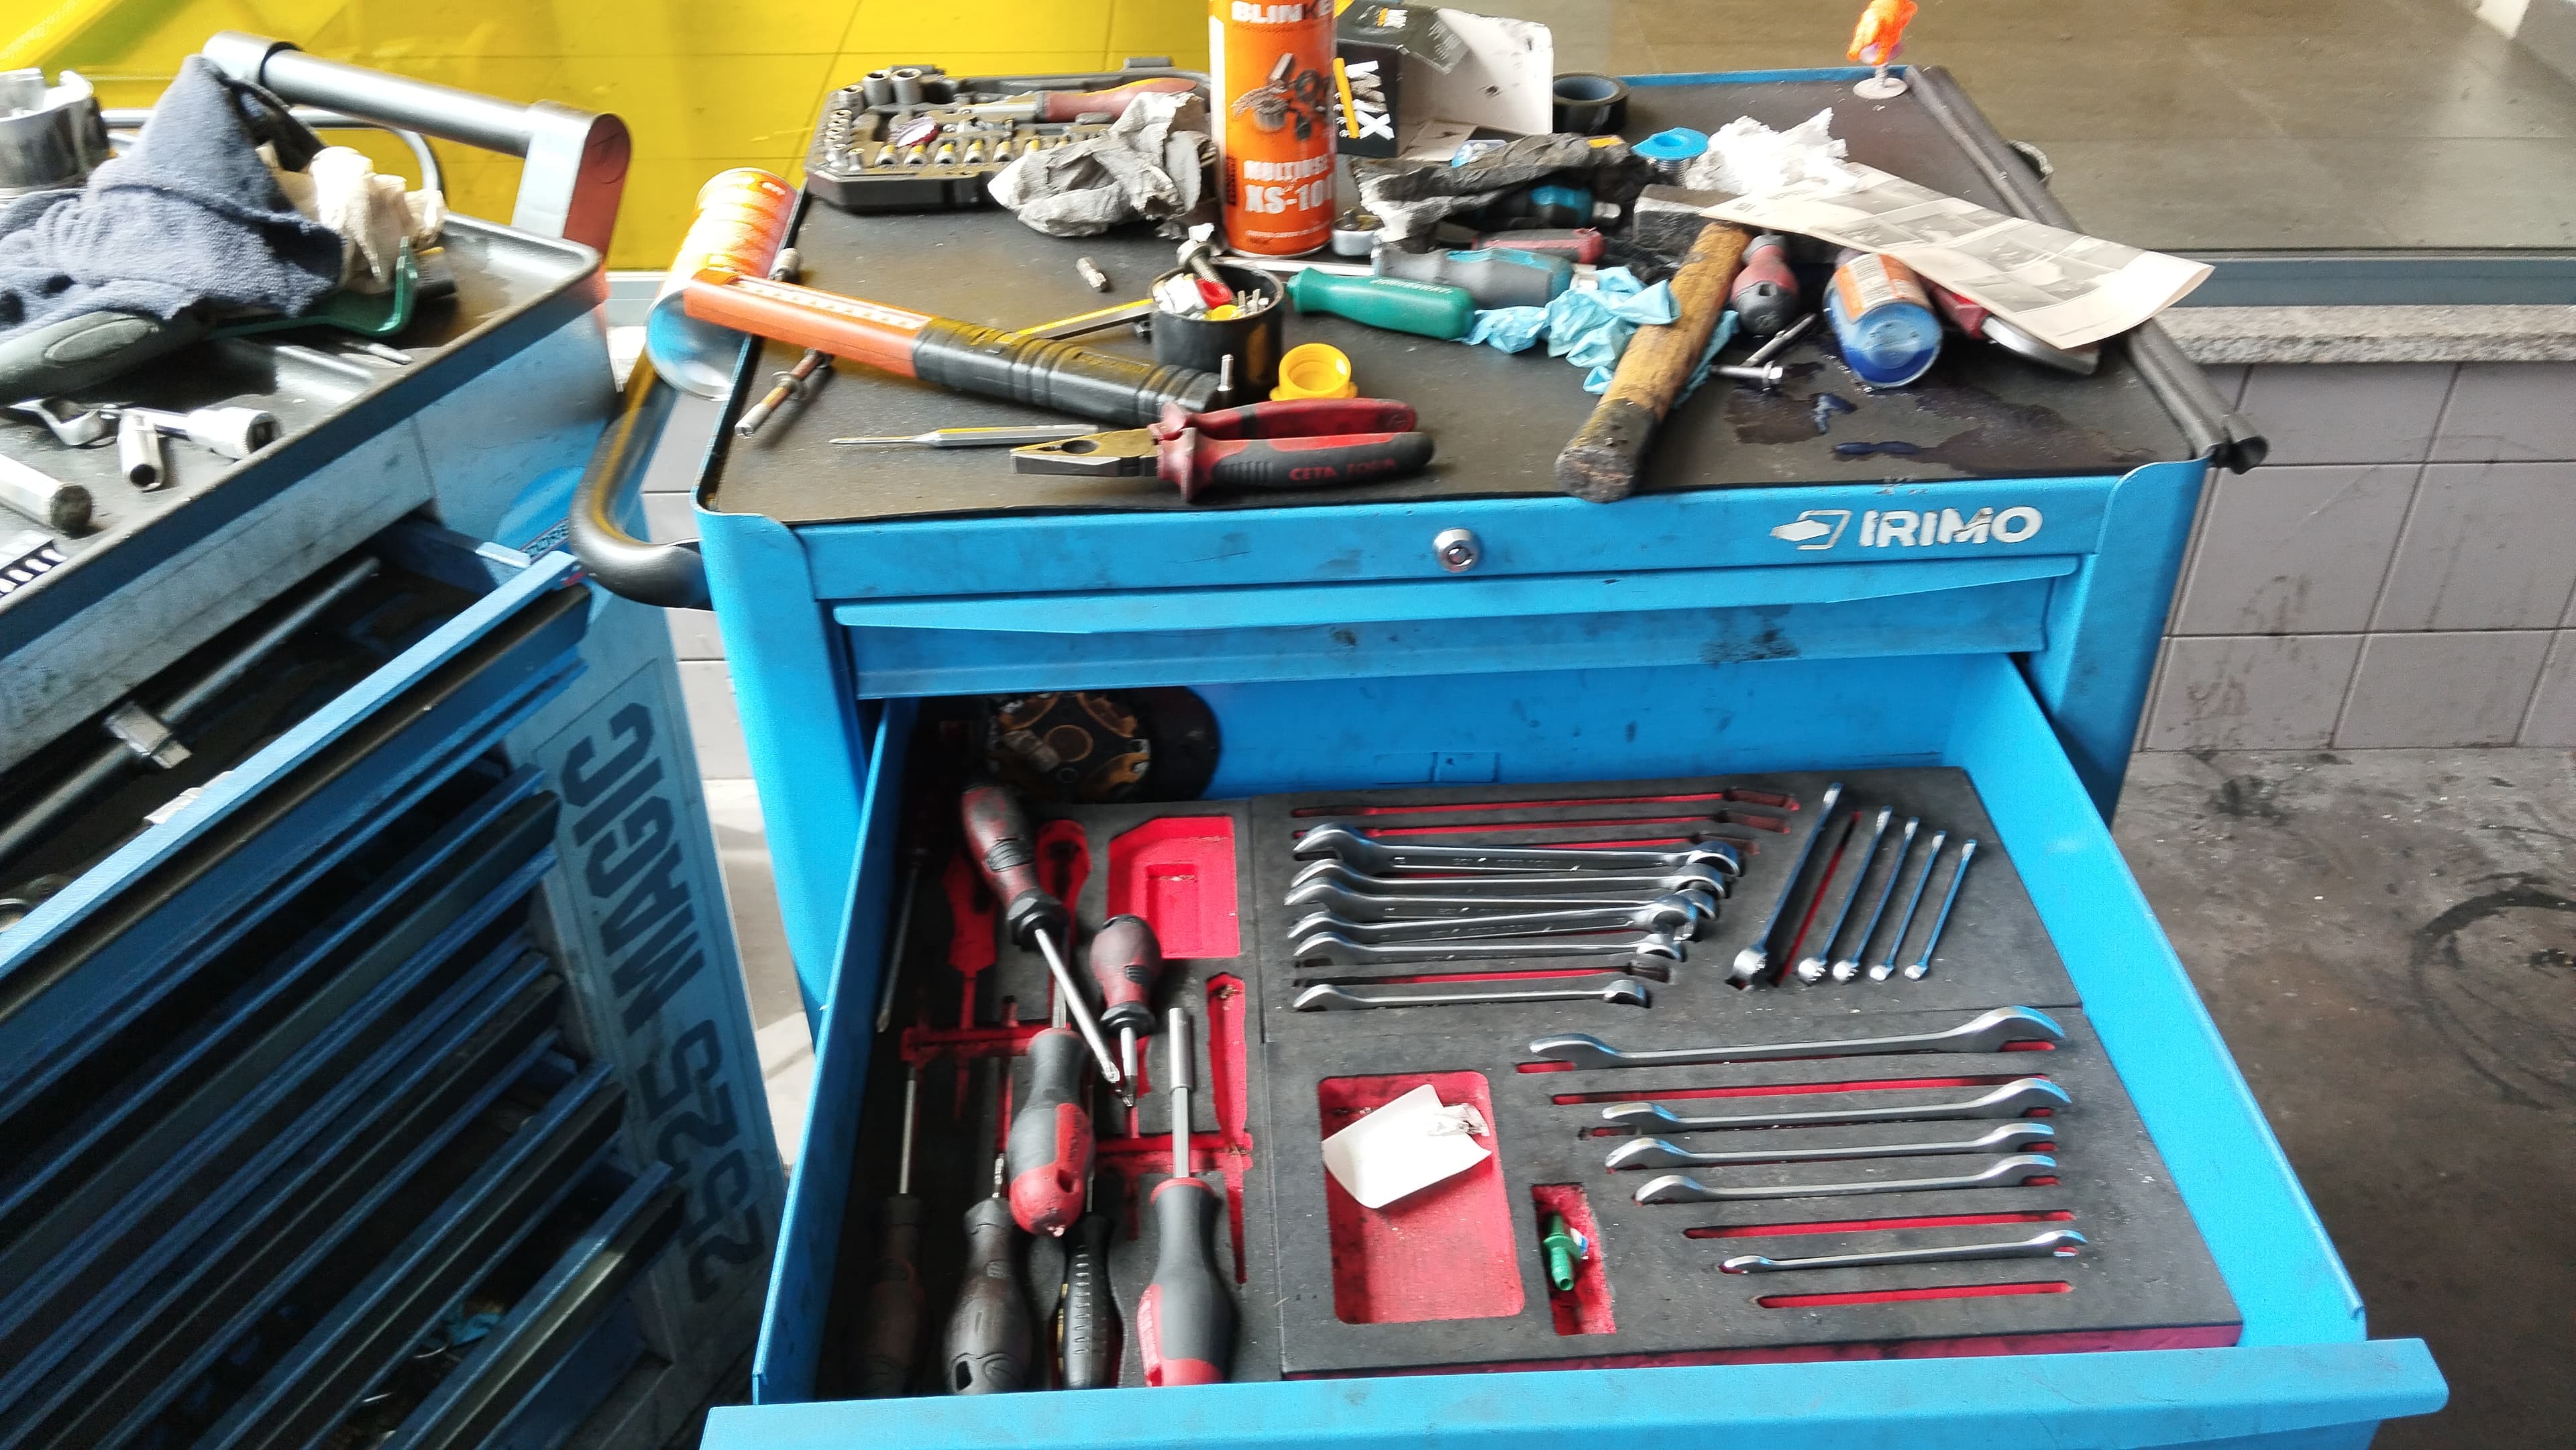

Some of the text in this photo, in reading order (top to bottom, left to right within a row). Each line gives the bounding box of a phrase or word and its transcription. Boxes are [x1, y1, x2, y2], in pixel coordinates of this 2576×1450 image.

[1289, 466, 1338, 481] CETA
[1860, 506, 2043, 547] IRIMO
[559, 702, 763, 1304] 2525 MAGIC
